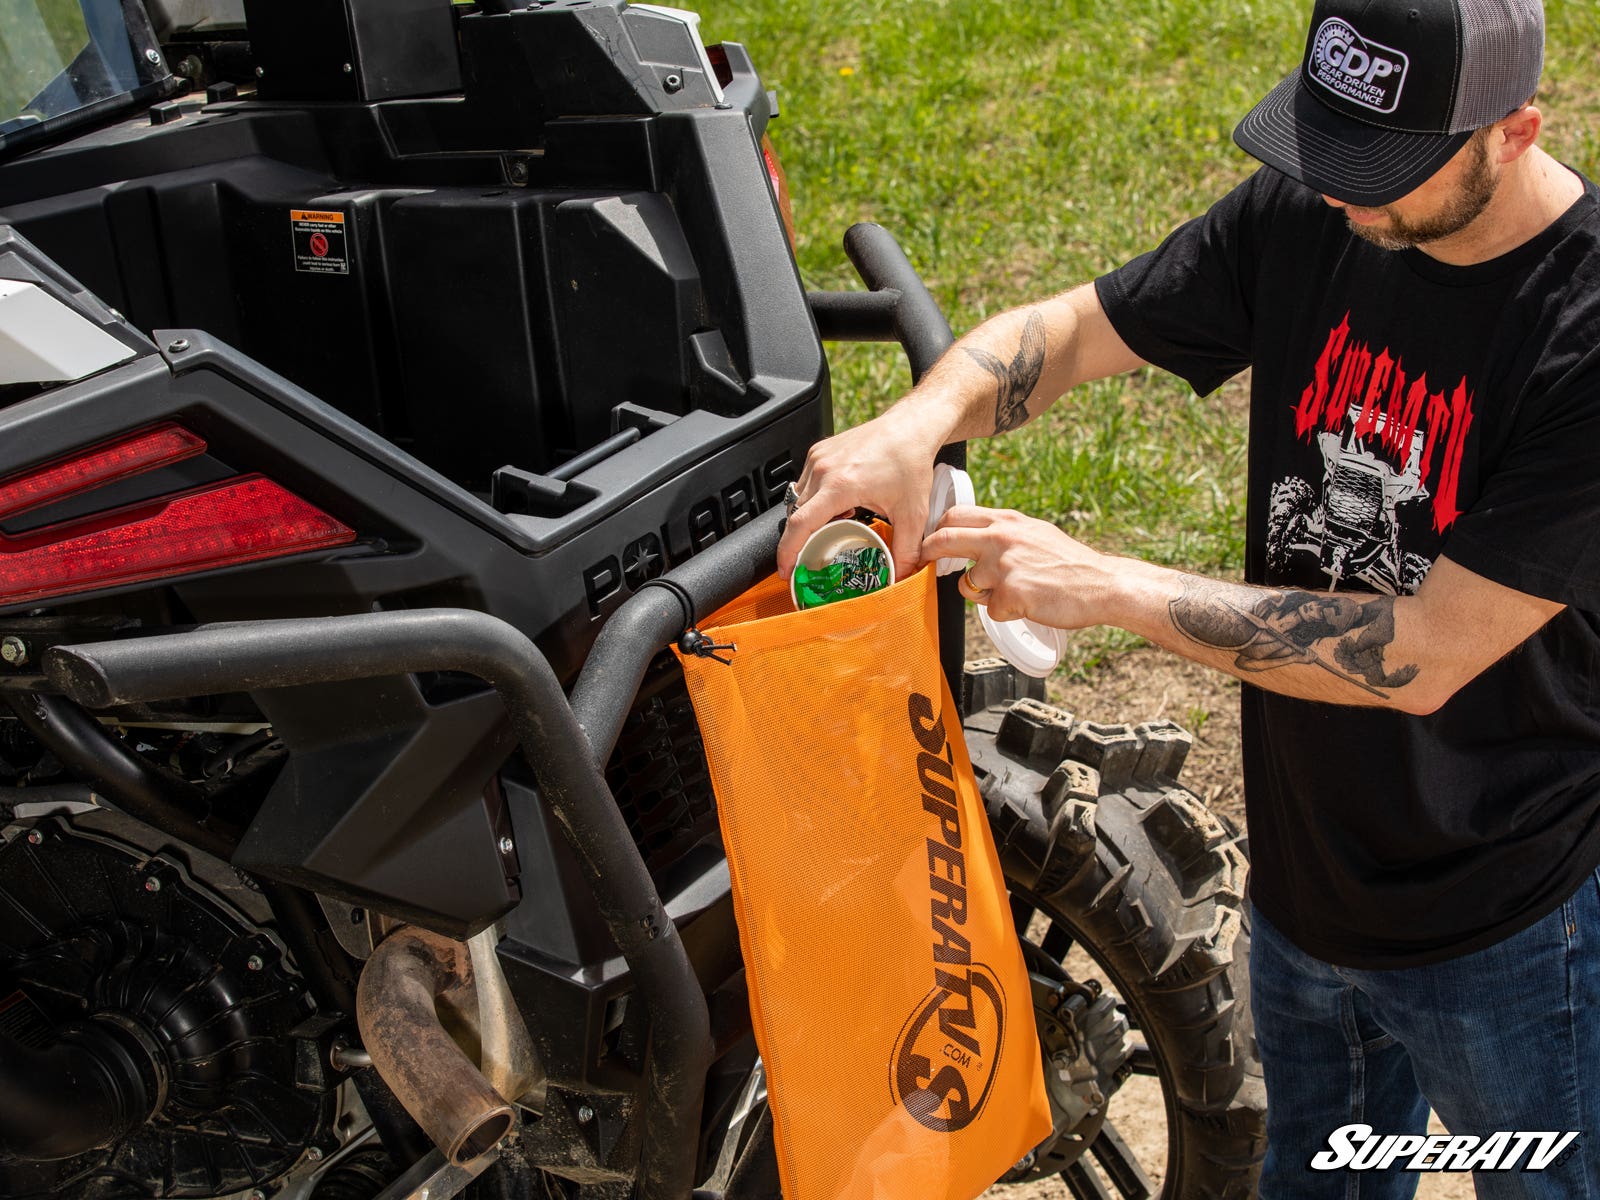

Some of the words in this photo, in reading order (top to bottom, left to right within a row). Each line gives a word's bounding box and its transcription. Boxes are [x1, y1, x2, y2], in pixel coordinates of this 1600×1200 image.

[1320, 61, 1344, 80] GEAR
[1343, 75, 1386, 97] DRIVEN
[1325, 37, 1393, 84] GDP
[1317, 69, 1384, 106] PERFORMANCE
[308, 213, 334, 221] WARNING
[1290, 309, 1474, 536] SUPERATV
[583, 452, 794, 621] POLARIS
[908, 693, 981, 1057] SUPERATV
